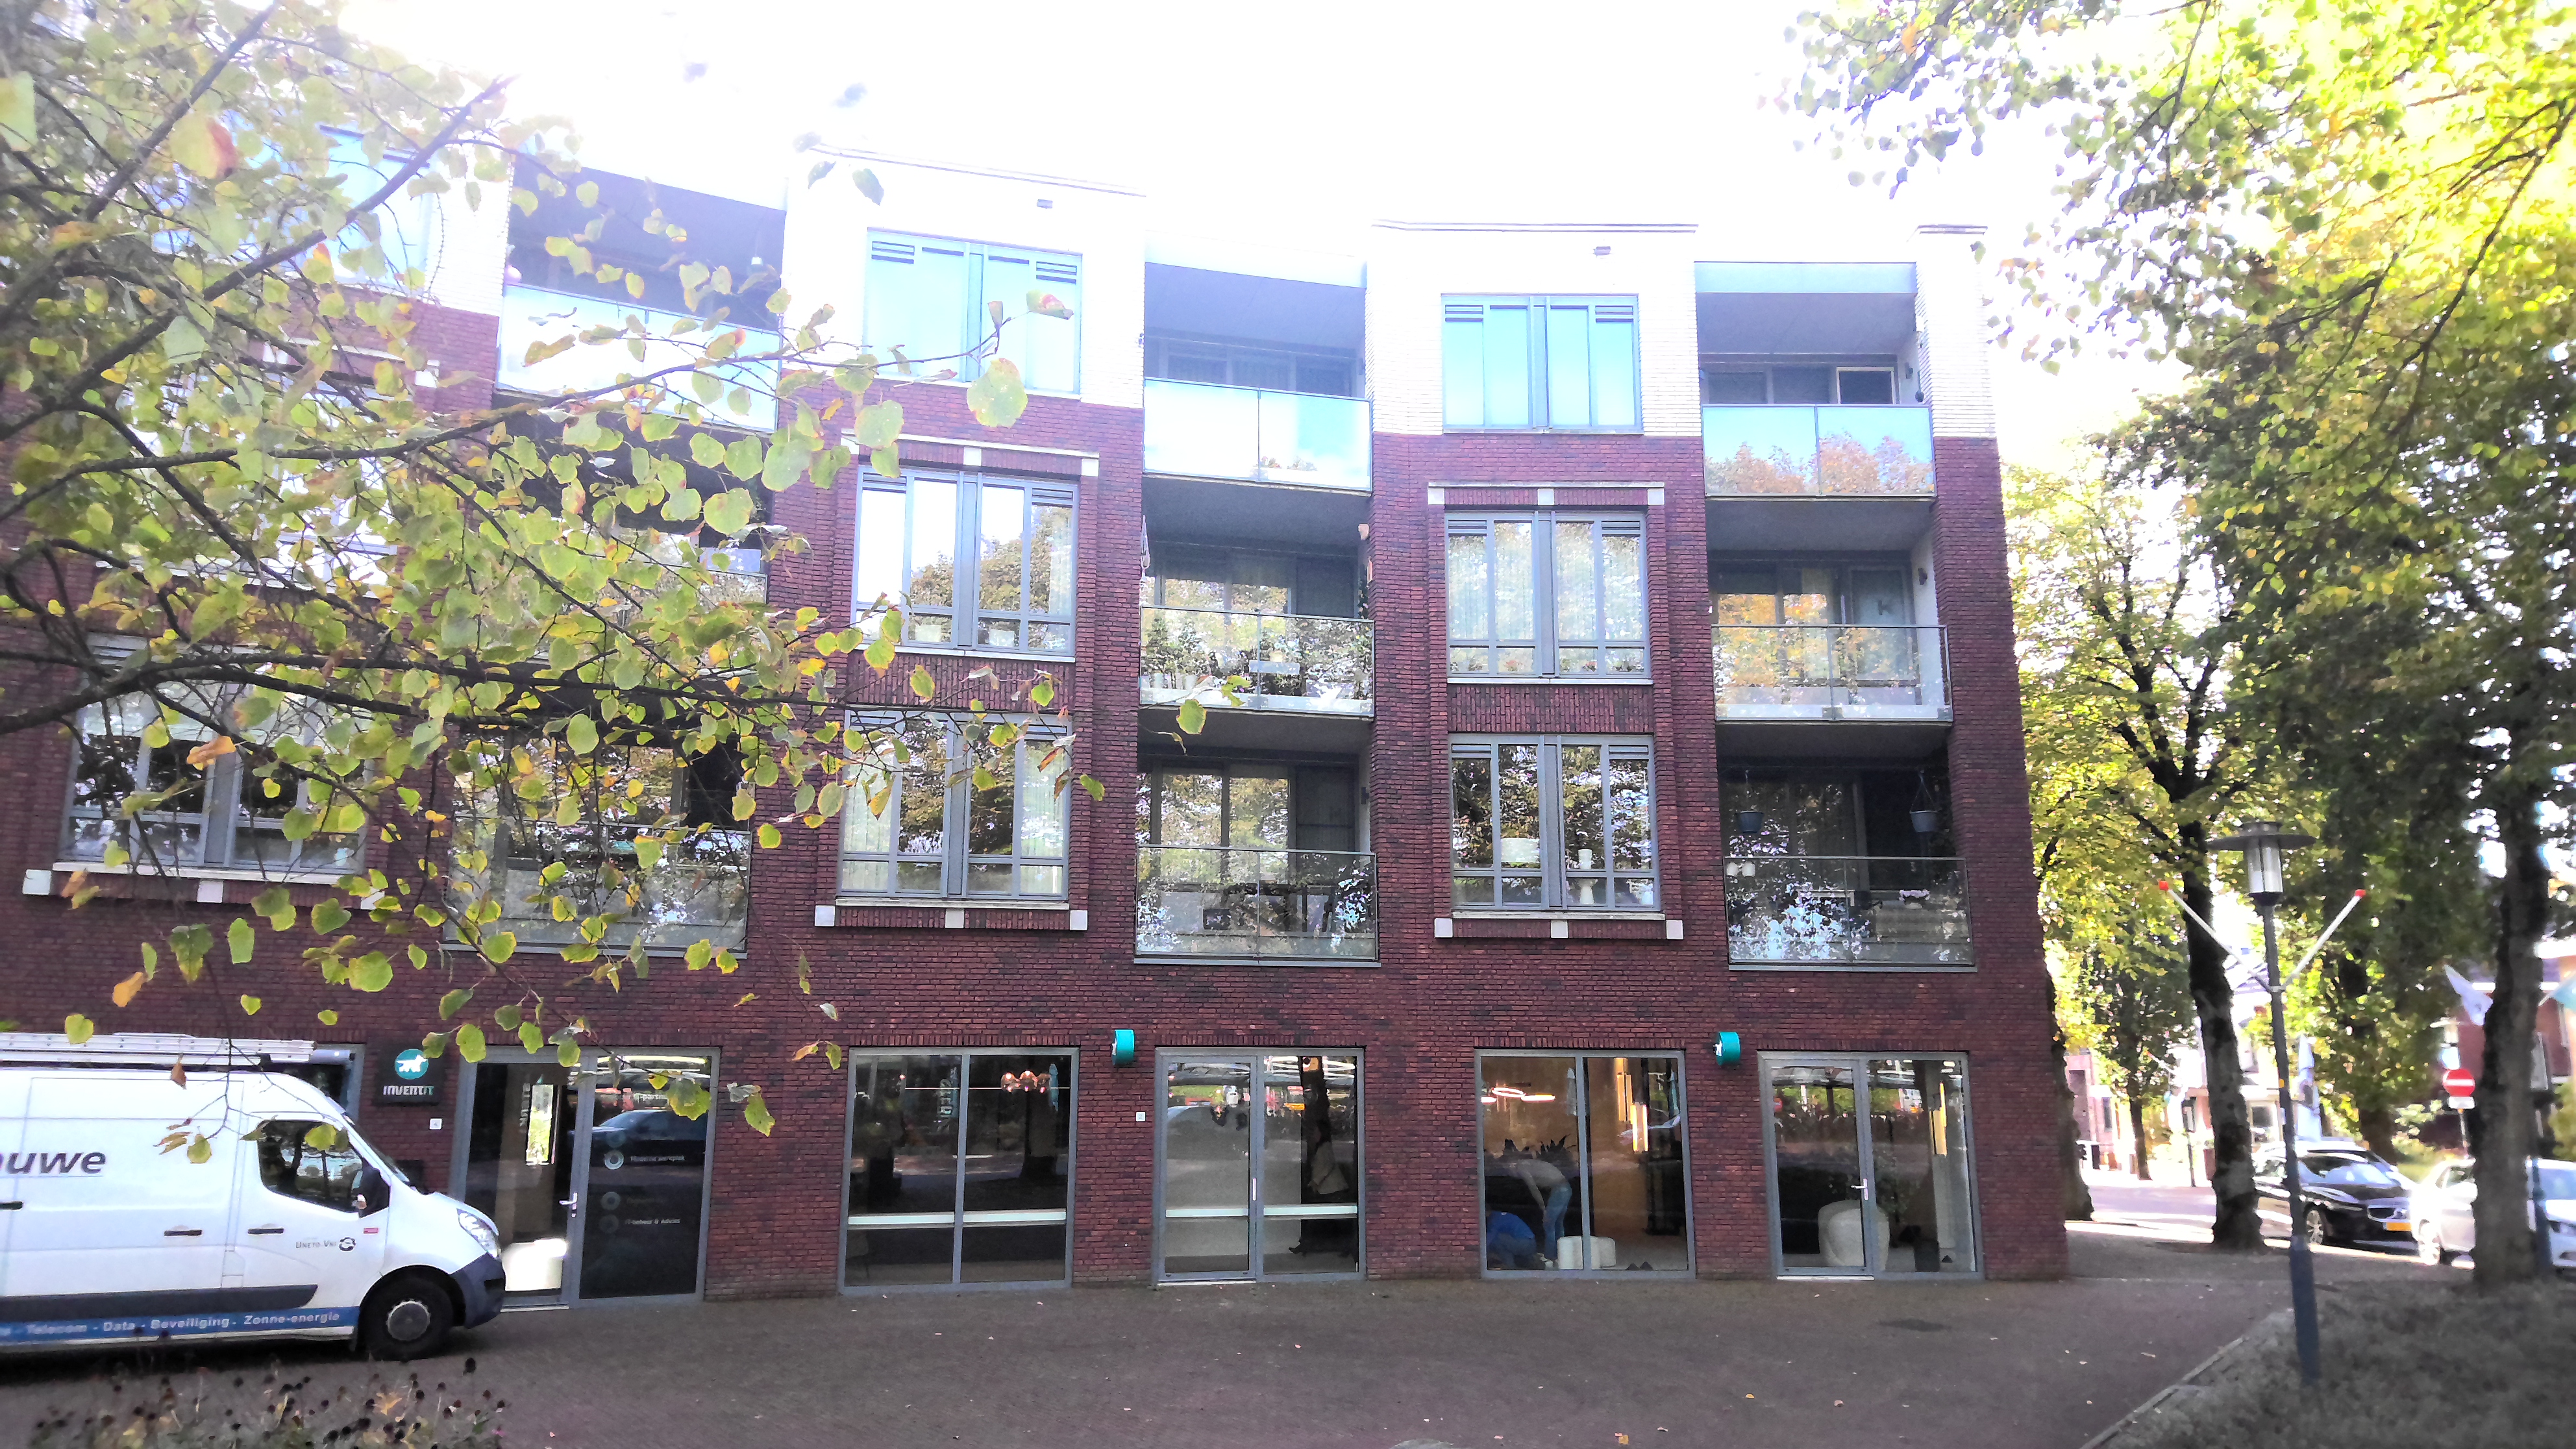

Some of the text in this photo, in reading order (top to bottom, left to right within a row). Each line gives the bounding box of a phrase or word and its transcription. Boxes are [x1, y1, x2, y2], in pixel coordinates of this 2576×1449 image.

[0, 1152, 106, 1174] uwe
[104, 1322, 135, 1331] Data
[151, 1317, 230, 1329] Beveiliging
[244, 1312, 339, 1325] Zonne-energie
